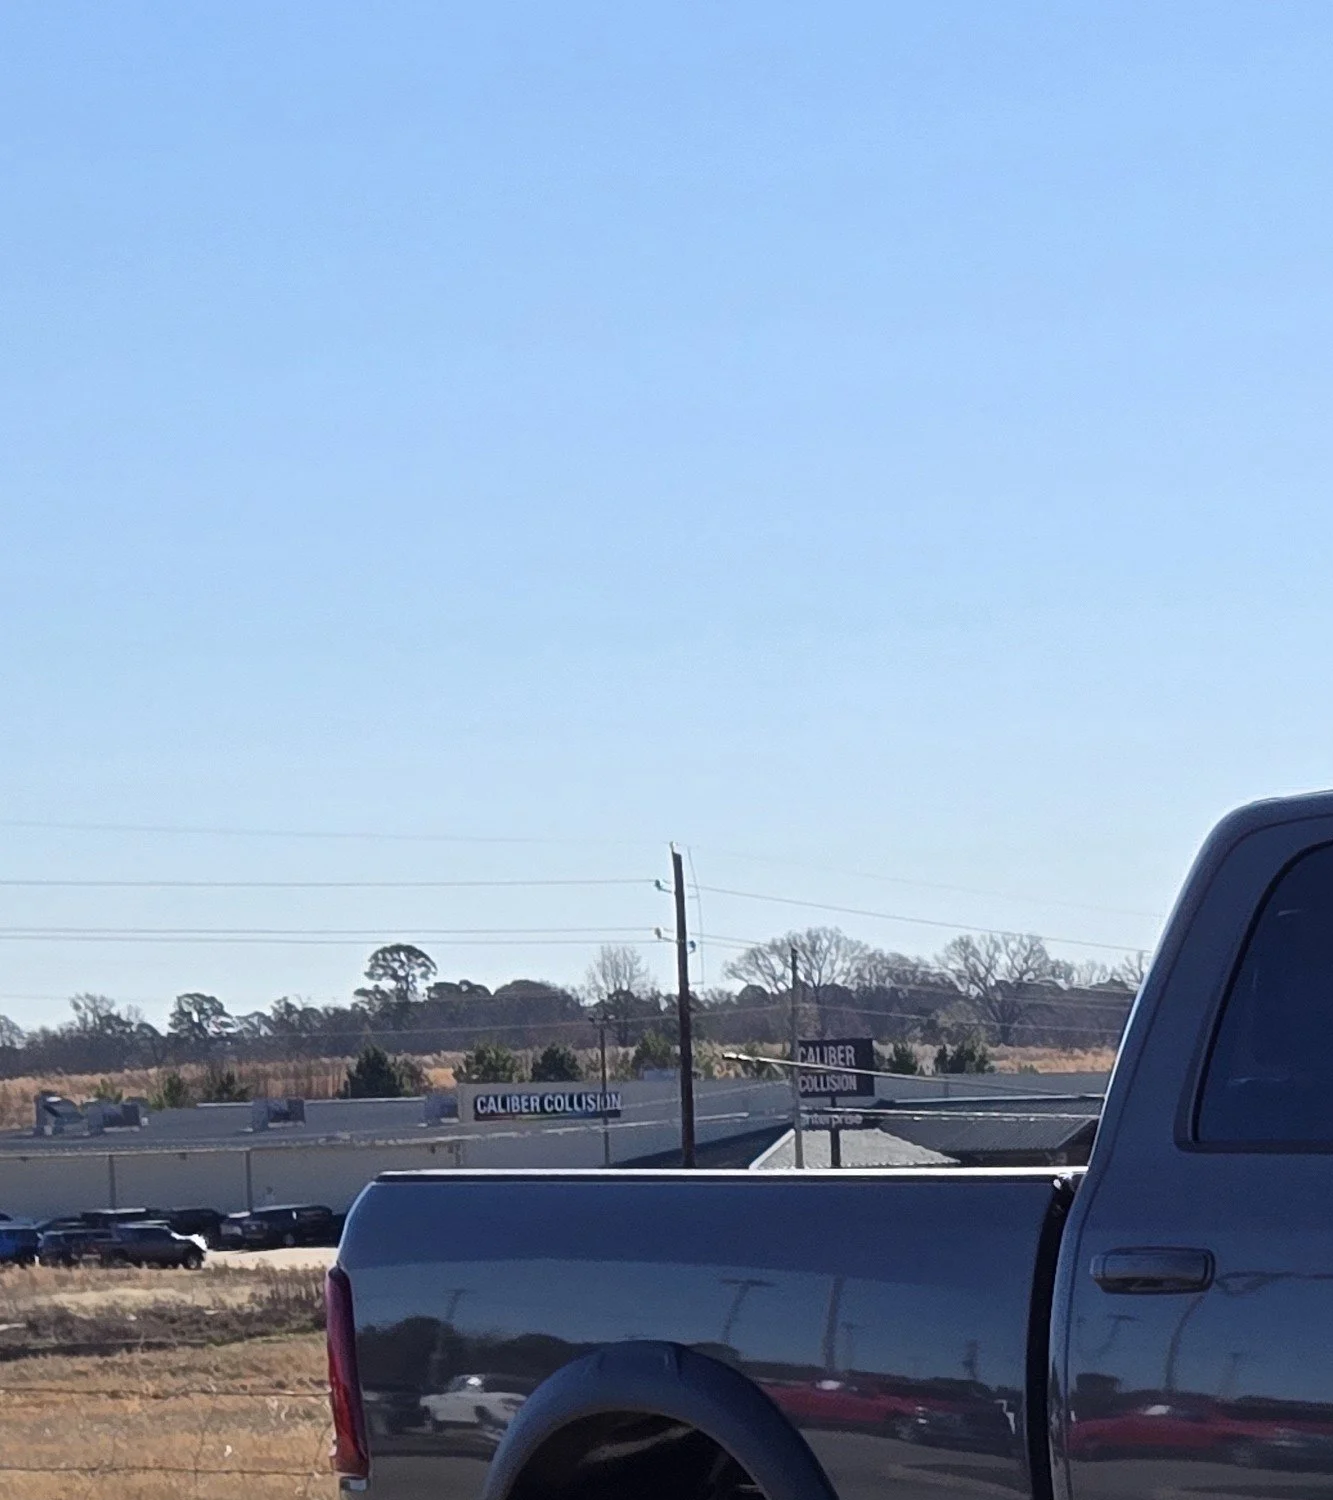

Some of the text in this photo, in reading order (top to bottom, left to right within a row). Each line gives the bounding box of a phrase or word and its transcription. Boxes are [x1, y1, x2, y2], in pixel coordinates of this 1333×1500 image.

[799, 1045, 856, 1067] CALIBER
[799, 1074, 857, 1093] COLLISION
[476, 1092, 621, 1114] CALIBER COLLISION
